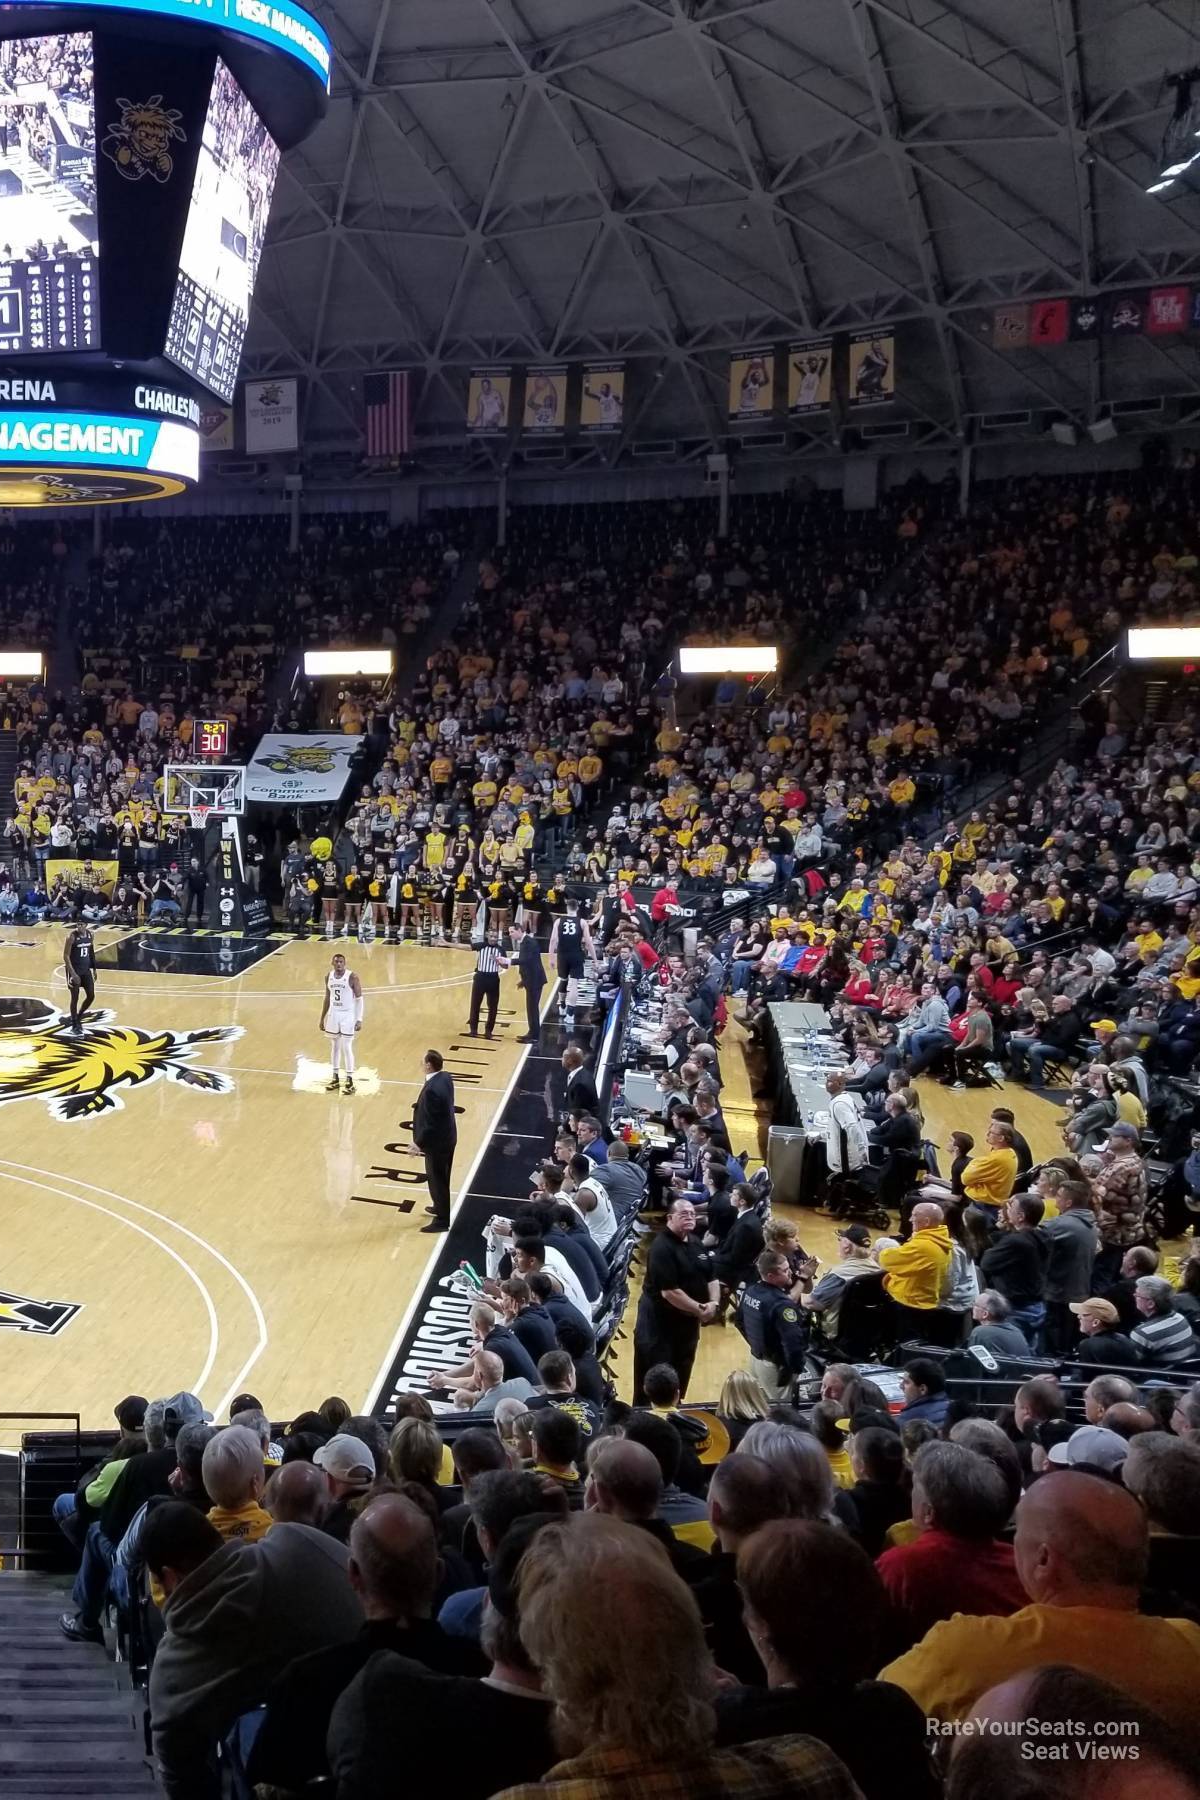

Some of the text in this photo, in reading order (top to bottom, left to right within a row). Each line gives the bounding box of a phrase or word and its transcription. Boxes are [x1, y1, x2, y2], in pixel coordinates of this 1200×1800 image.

[236, 0, 271, 27] RISK
[134, 386, 190, 417] CHARLES
[203, 723, 225, 733] 9:27
[202, 734, 221, 751] 30
[251, 786, 327, 794] Commerce
[220, 840, 232, 879] WSU
[562, 922, 577, 935] 33
[80, 947, 88, 958] 13
[350, 1101, 467, 1214] URT
